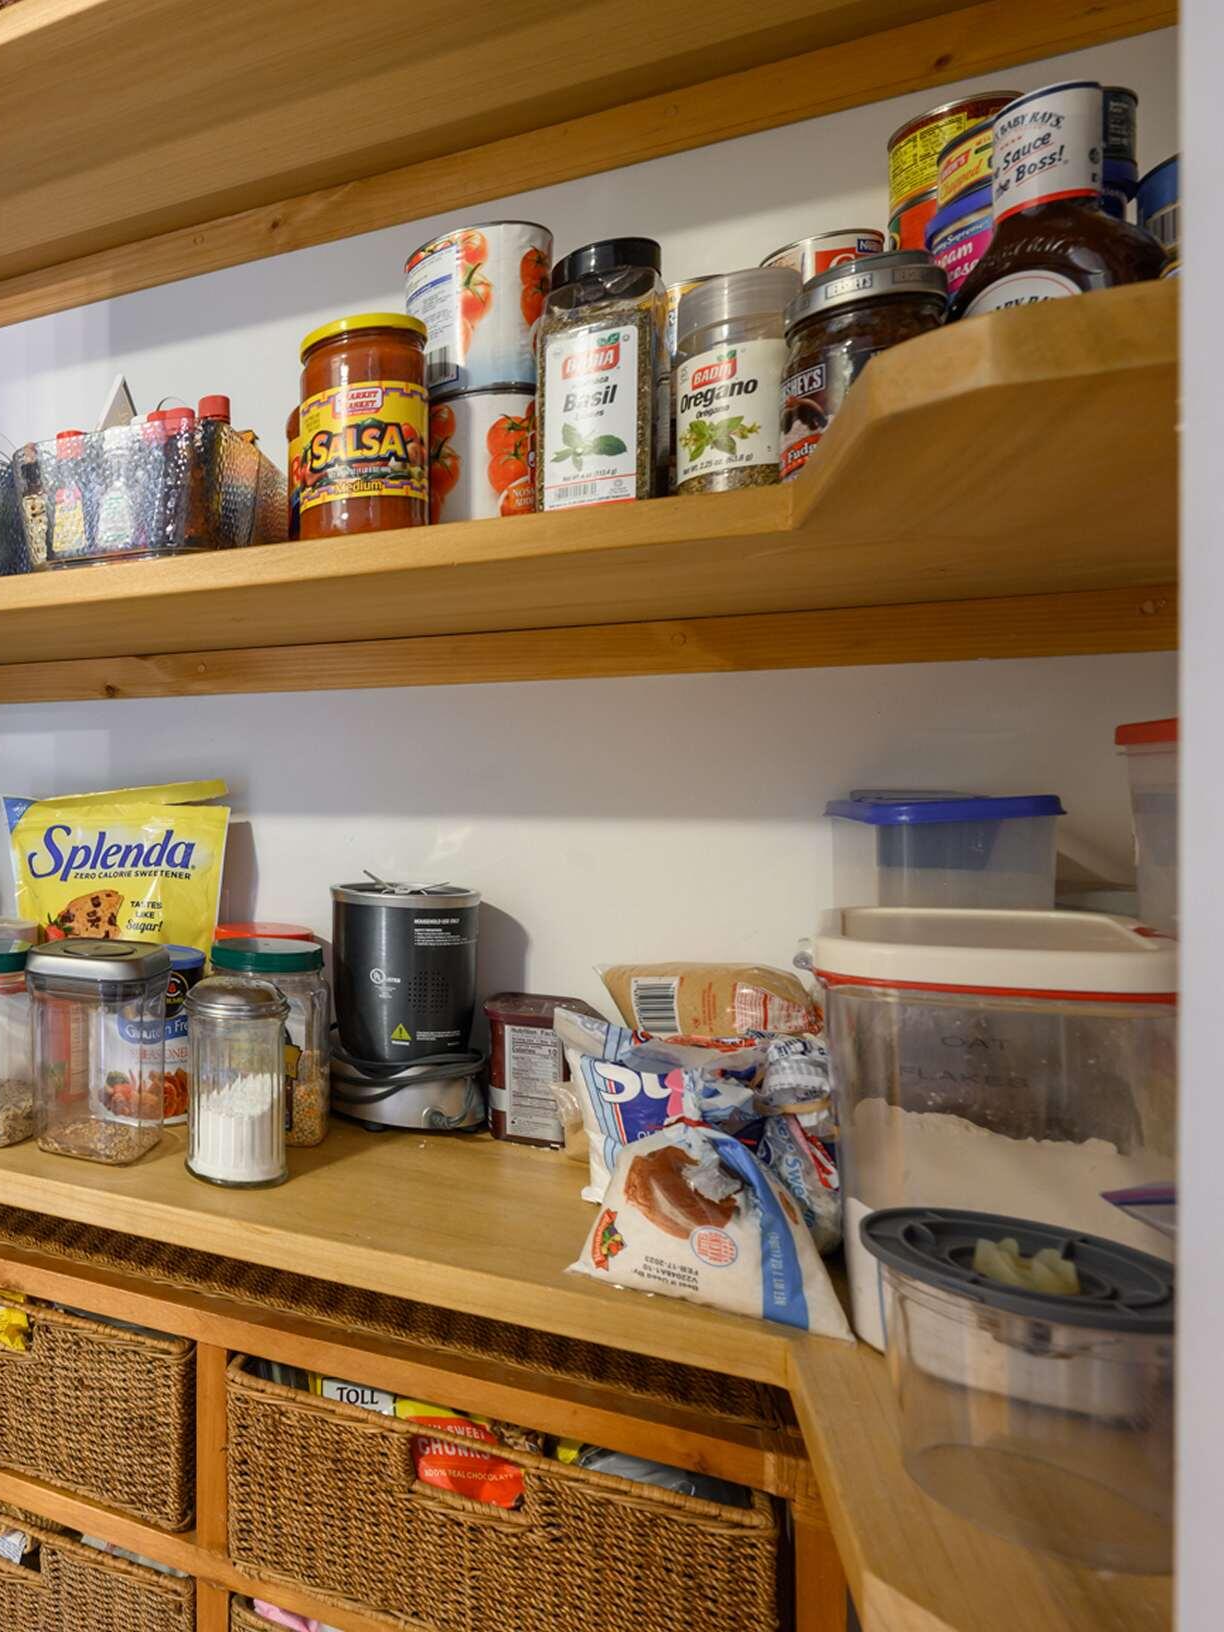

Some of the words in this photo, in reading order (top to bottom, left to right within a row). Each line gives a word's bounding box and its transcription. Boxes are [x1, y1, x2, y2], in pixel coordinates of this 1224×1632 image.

[937, 242, 973, 268] eam
[680, 378, 758, 413] Oregano
[311, 423, 407, 471] SALSA
[28, 824, 194, 882] Splenda
[74, 871, 96, 880] ZERO
[98, 870, 132, 880] CALORIE
[134, 870, 192, 880] SWEETENER
[130, 900, 163, 910] TASTES
[135, 911, 155, 920] LIKE
[126, 920, 163, 934] Sugar!
[336, 1387, 379, 1405] TOLL
